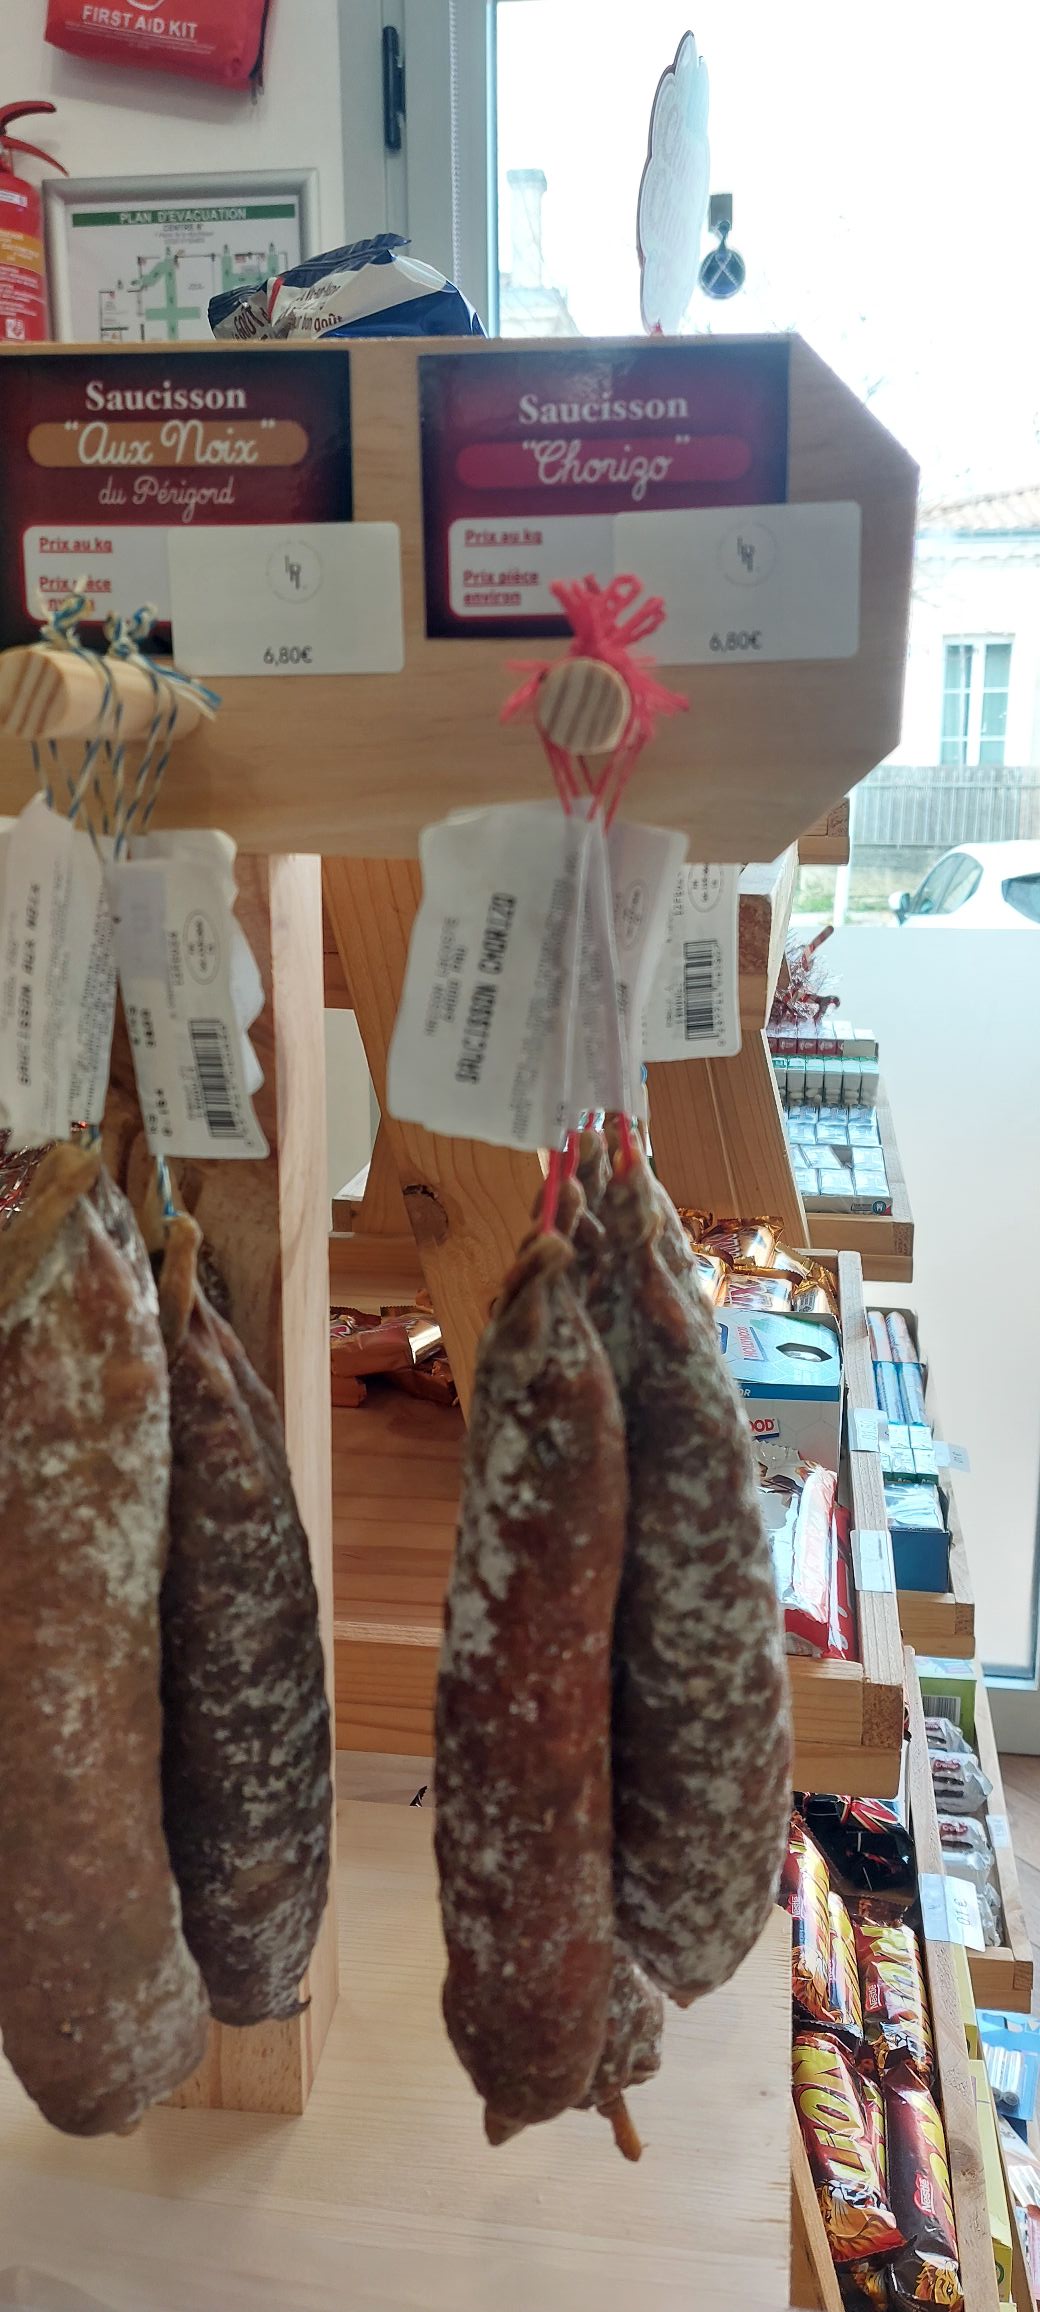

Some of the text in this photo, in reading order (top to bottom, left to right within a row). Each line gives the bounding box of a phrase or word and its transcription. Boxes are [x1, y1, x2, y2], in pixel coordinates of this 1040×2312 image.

[82, 5, 133, 28] FIRST
[135, 16, 165, 34] AID
[168, 20, 198, 39] KIT
[119, 207, 247, 224] PLAN D'EVACUATION
[85, 380, 248, 411] Saucisson
[518, 391, 690, 425] Saucisson
[98, 474, 236, 524] du Périgord
[39, 537, 69, 554] Prix
[72, 541, 91, 554] au
[464, 529, 497, 548] Prix
[500, 532, 520, 547] au
[39, 576, 68, 593] Prix
[463, 567, 540, 588] Prix pièce
[463, 591, 522, 608] environ
[708, 630, 763, 653] 6,80€
[263, 645, 313, 666] 6,80€
[454, 892, 518, 1085] SAUCISSON CHORIZO
[792, 2044, 877, 2188] LION
